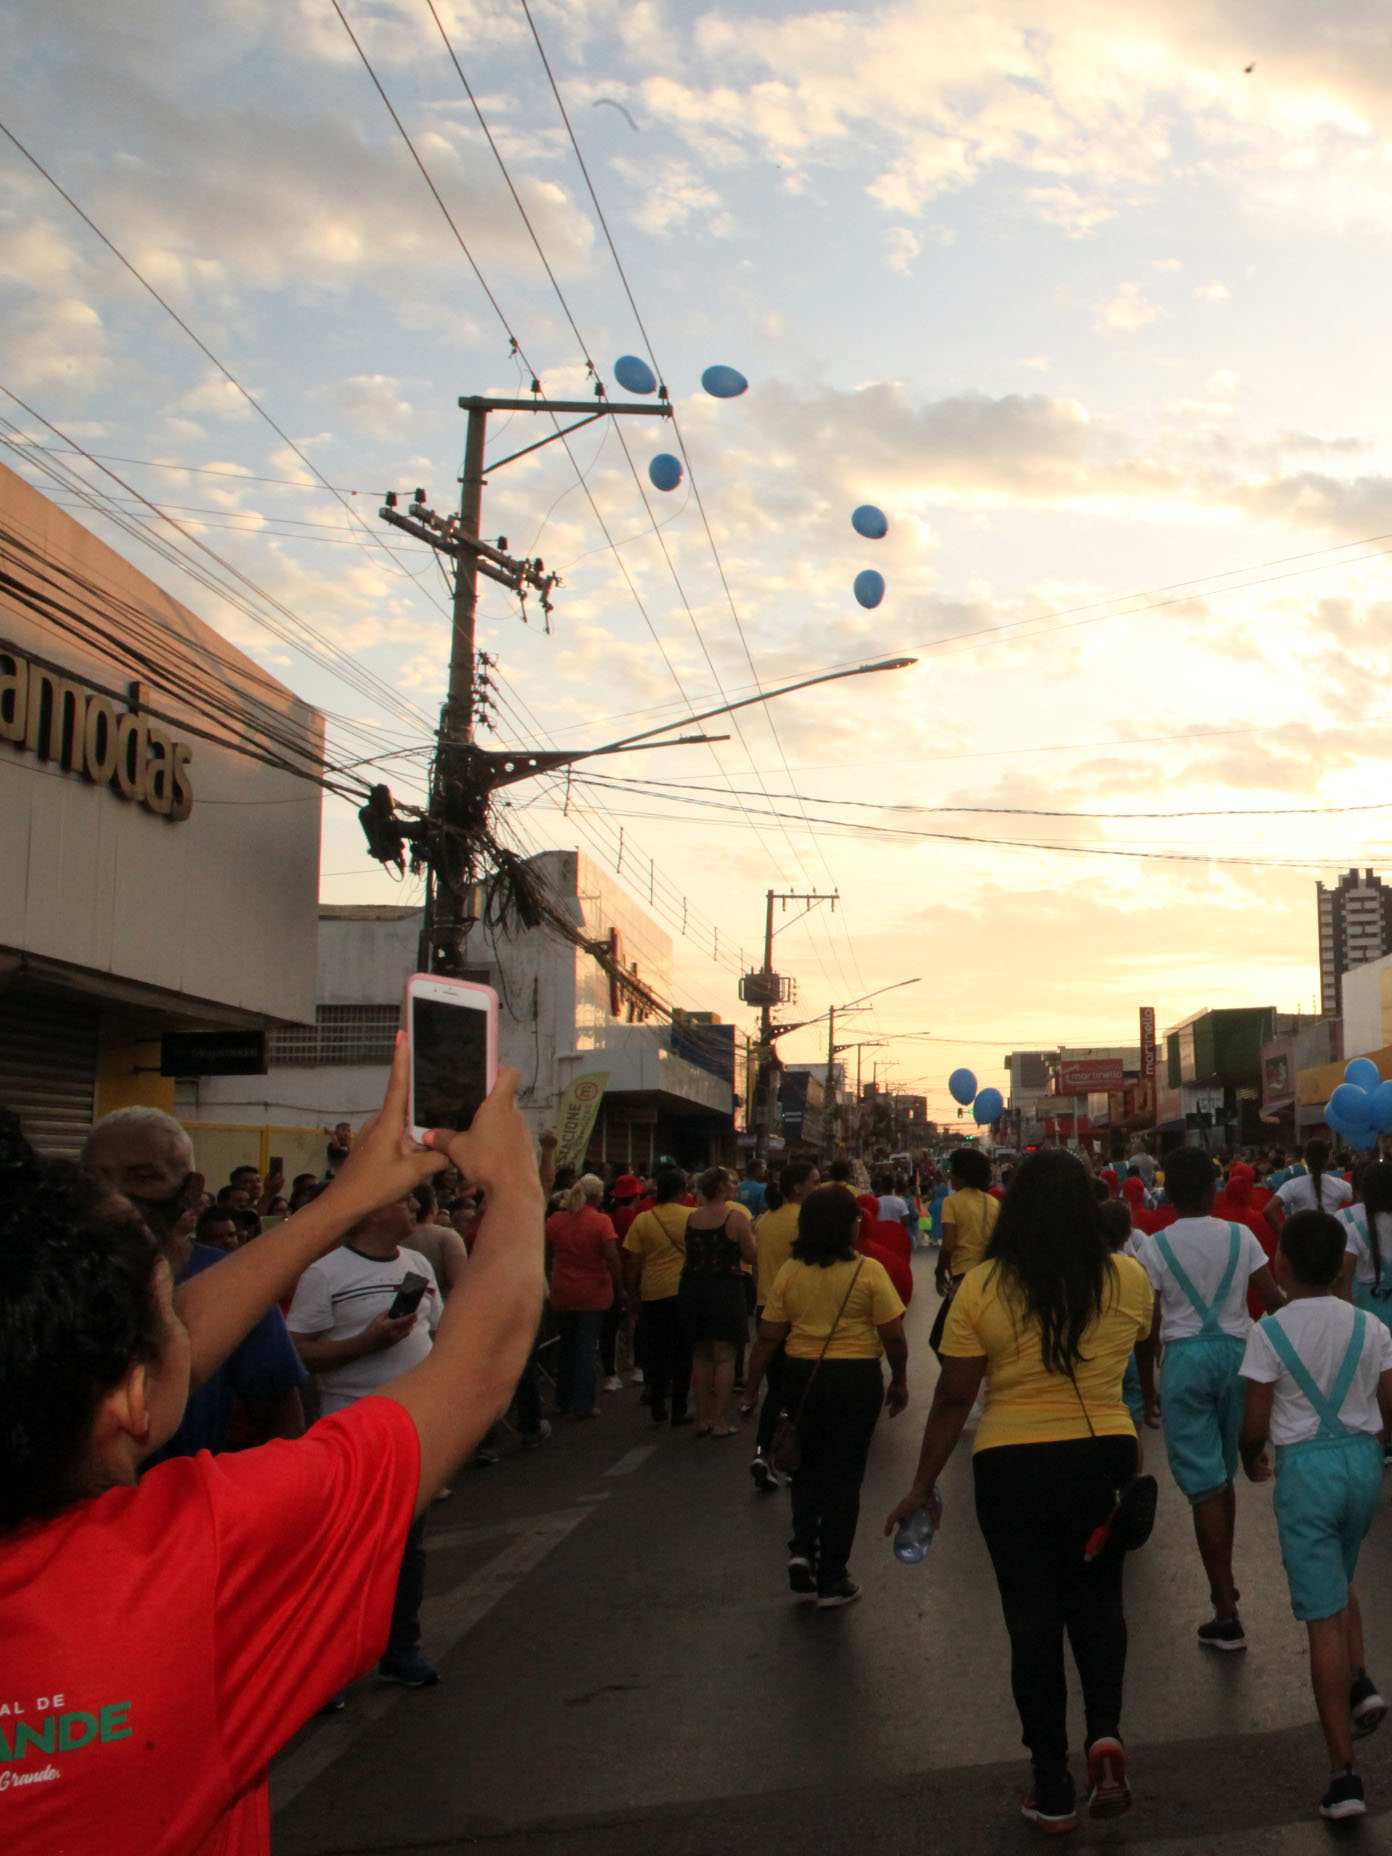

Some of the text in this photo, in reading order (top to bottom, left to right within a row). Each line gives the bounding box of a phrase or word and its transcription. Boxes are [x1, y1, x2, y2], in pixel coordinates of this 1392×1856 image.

[0, 648, 194, 822] amodas
[1142, 1008, 1154, 1075] martinello
[36, 1693, 65, 1711] DE
